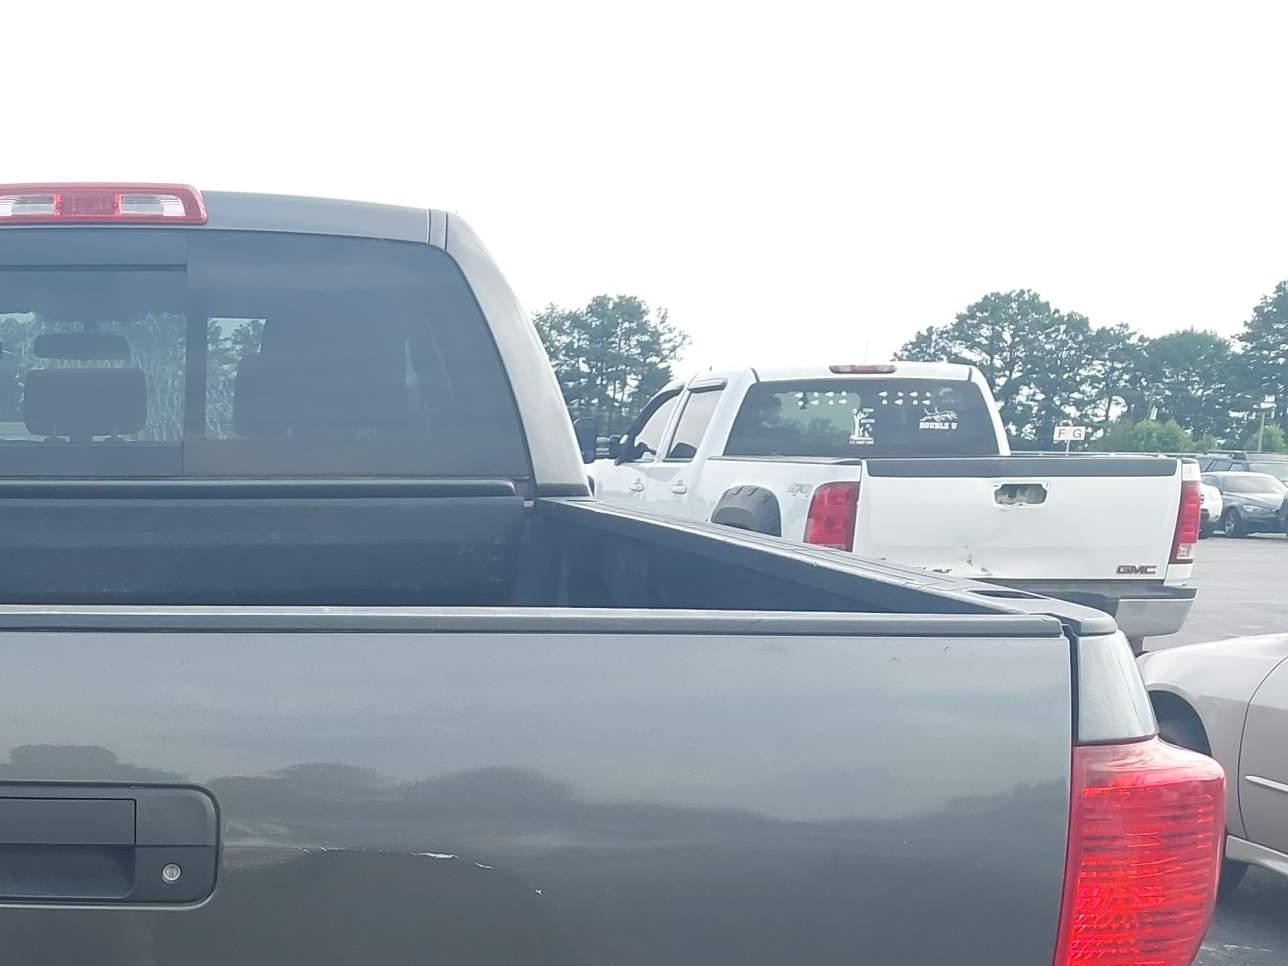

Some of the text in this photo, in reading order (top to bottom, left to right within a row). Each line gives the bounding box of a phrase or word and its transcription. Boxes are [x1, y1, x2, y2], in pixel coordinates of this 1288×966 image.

[1058, 428, 1082, 438] F G
[1116, 565, 1157, 574] GMC
